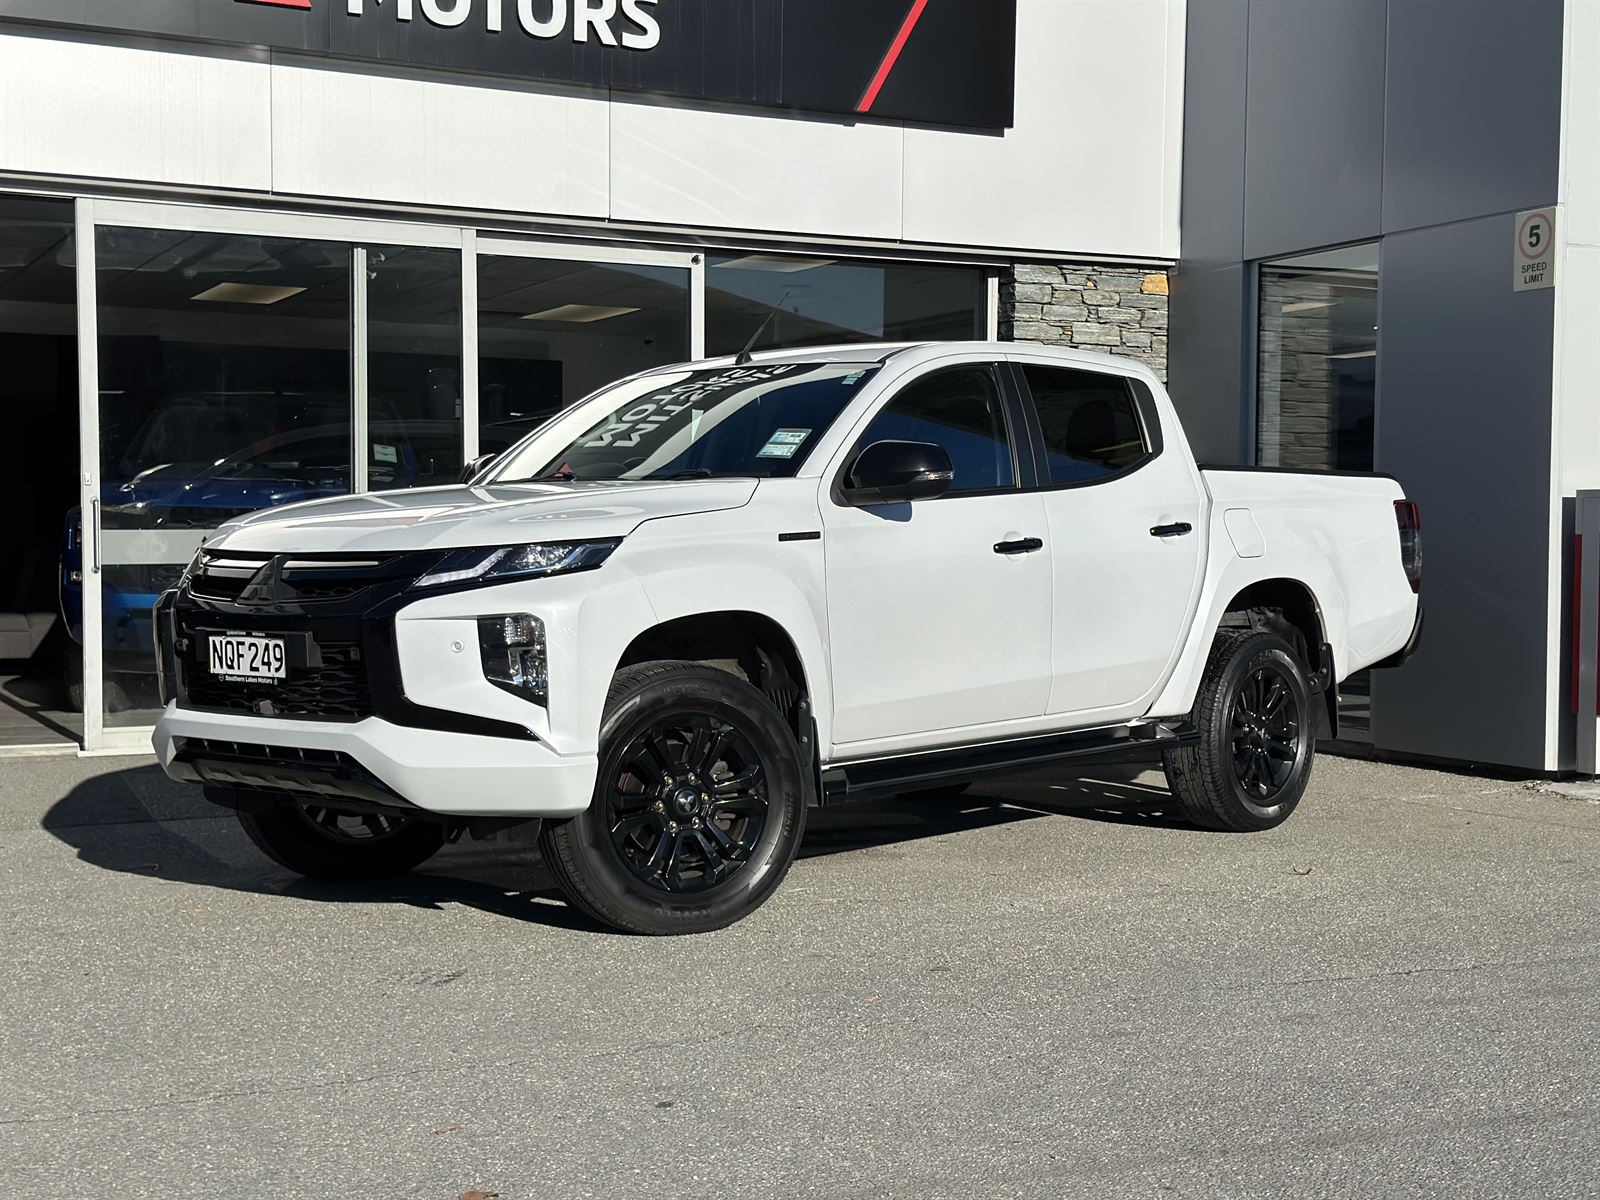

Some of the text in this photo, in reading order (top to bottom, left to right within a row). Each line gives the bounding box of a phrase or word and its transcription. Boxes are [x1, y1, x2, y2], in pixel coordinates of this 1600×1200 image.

[1528, 224, 1541, 248] 5
[1521, 262, 1547, 273] SPEED
[1524, 273, 1544, 284] LIMIT
